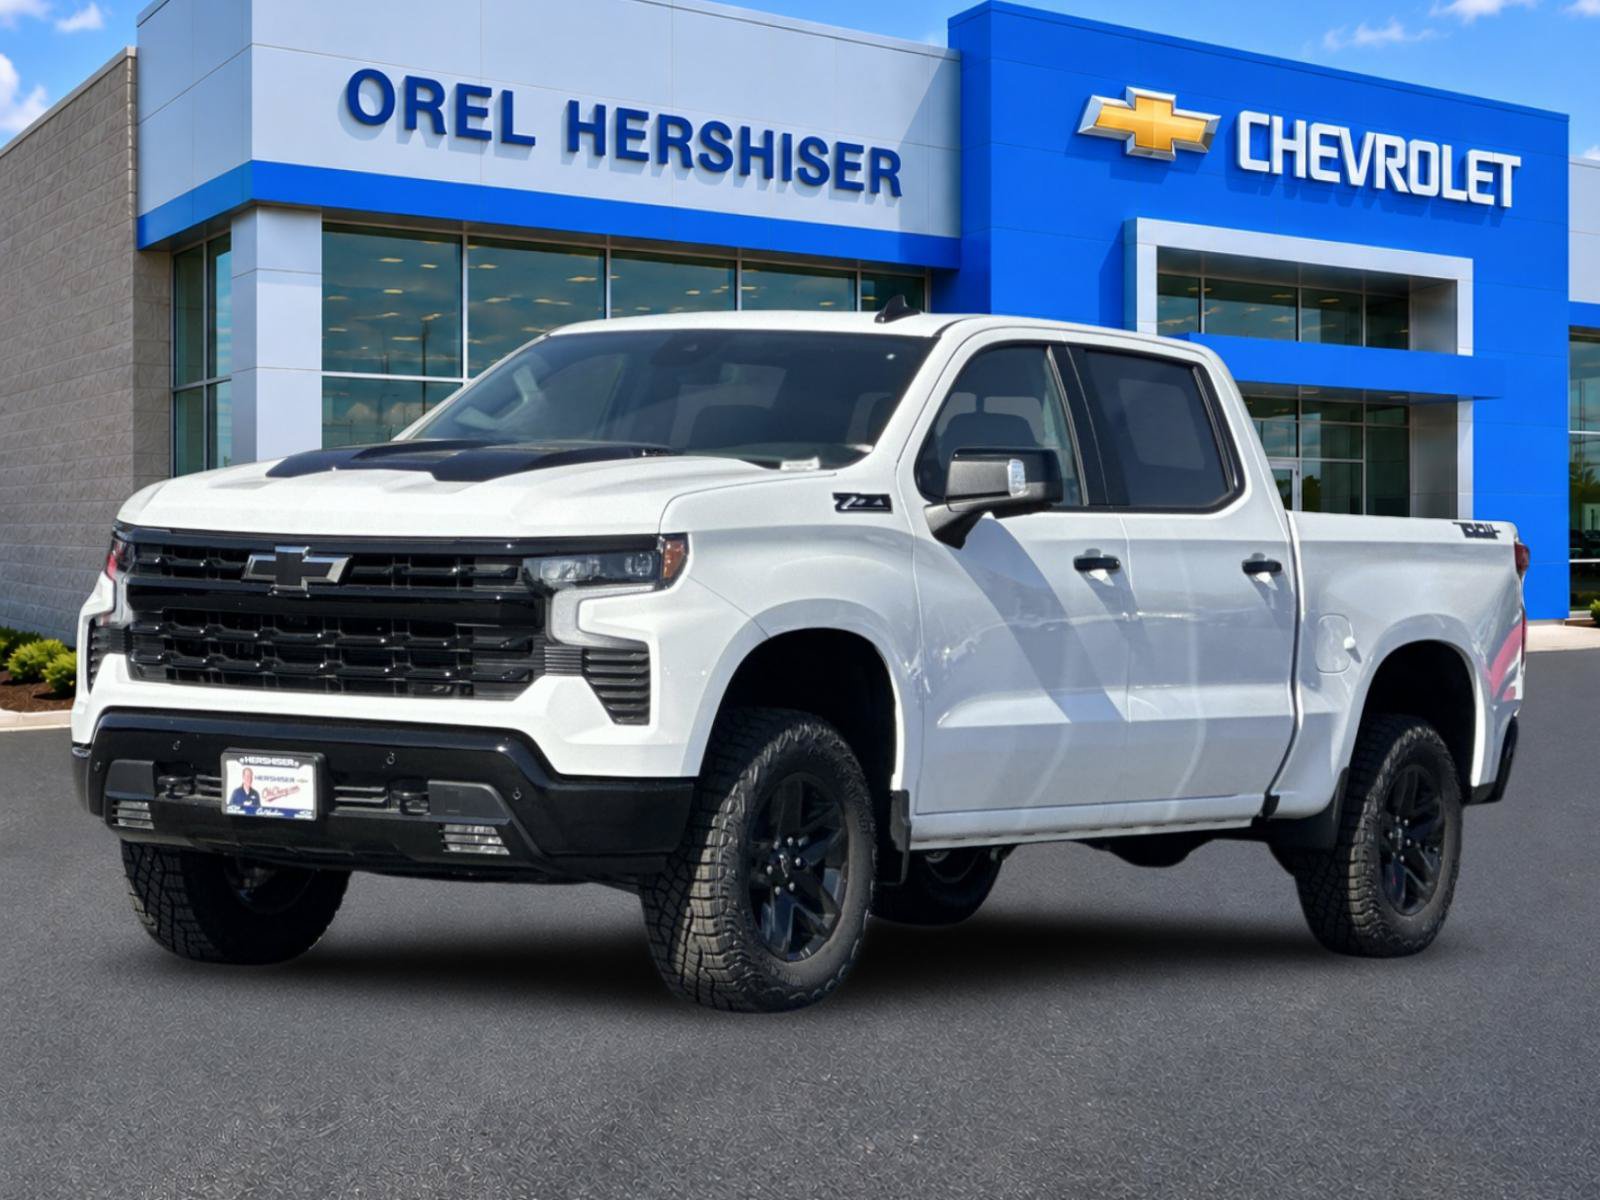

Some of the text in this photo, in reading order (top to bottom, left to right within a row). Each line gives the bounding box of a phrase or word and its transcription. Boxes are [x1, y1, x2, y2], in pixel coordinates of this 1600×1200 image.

[346, 68, 903, 197] OREL HERSHISER
[1236, 110, 1522, 208] CHEVROLET
